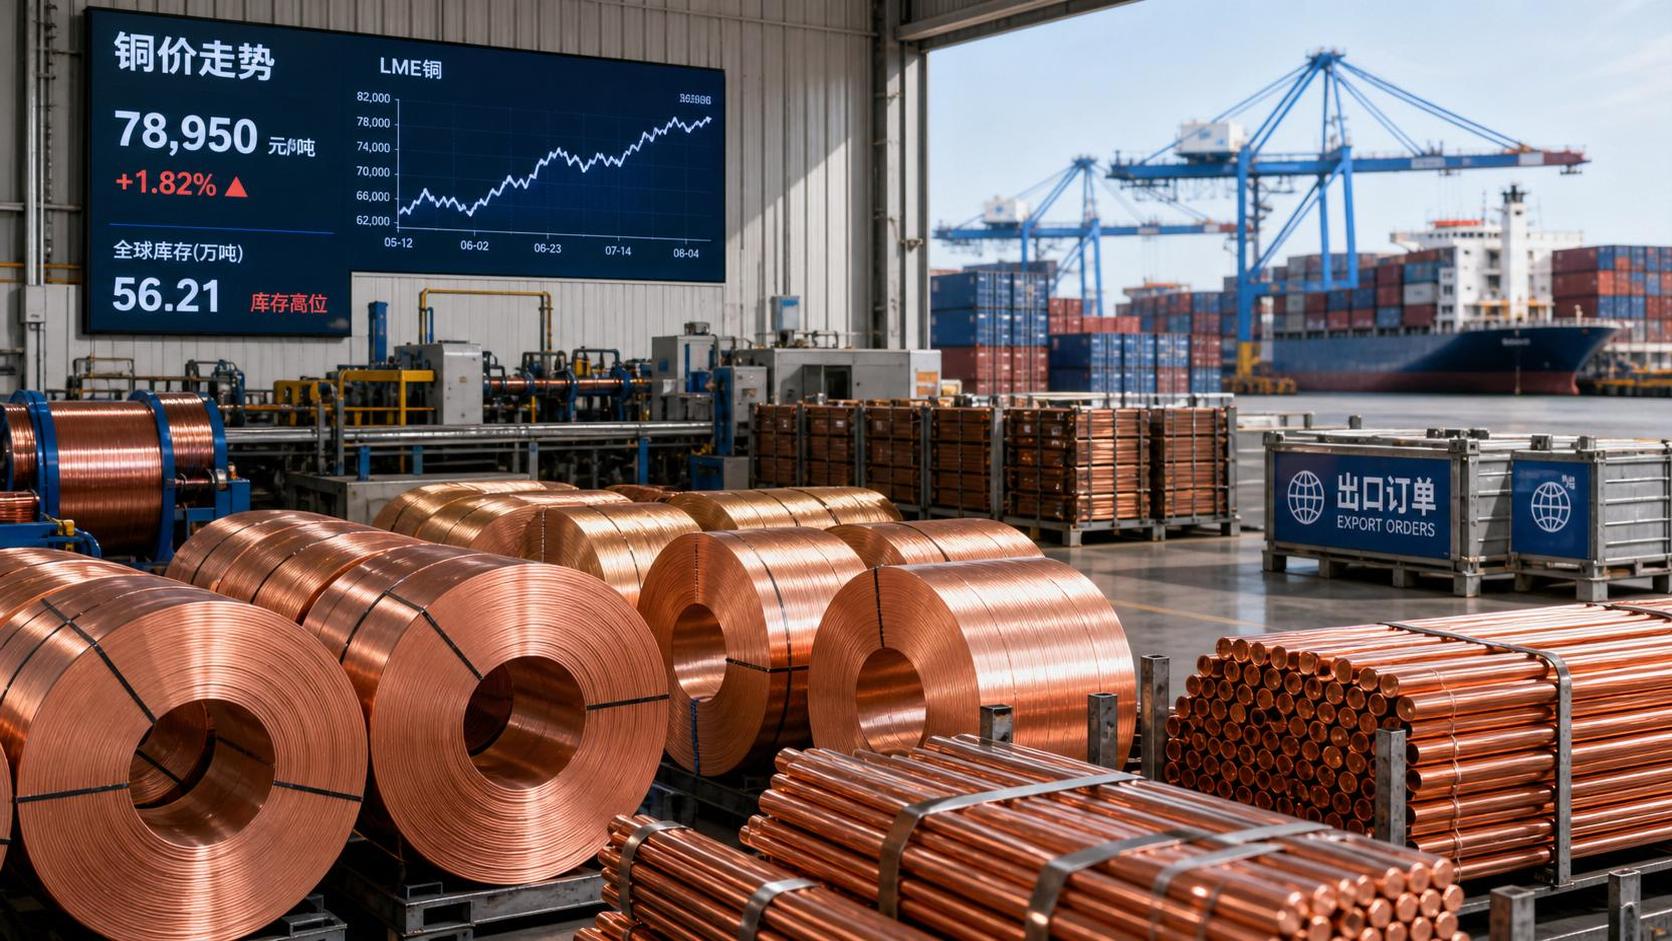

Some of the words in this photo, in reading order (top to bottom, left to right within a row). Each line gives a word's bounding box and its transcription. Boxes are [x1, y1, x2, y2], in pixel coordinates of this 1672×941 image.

[113, 31, 275, 81] 铜价走势
[380, 57, 442, 80] LME铜
[356, 92, 391, 104] 82,000
[356, 116, 391, 129] 78,000
[114, 110, 258, 157] 78,950
[356, 141, 391, 153] 74,000
[356, 166, 391, 178] 70,000
[115, 169, 217, 197] +1.82%
[356, 190, 391, 203] 66,000
[356, 215, 391, 227] 62,000
[384, 236, 413, 249] 05-12
[460, 239, 489, 252] 06-02
[534, 242, 562, 254] 06-23
[113, 239, 243, 264] 全球库存(万吨)
[605, 245, 632, 257] 07-14
[673, 248, 699, 259] 08-04
[112, 276, 218, 313] 56.21
[250, 292, 328, 314] 库存高位
[1337, 472, 1437, 517] 出口订单
[1337, 514, 1383, 532] EXPORT
[1385, 518, 1435, 538] ORDERS
